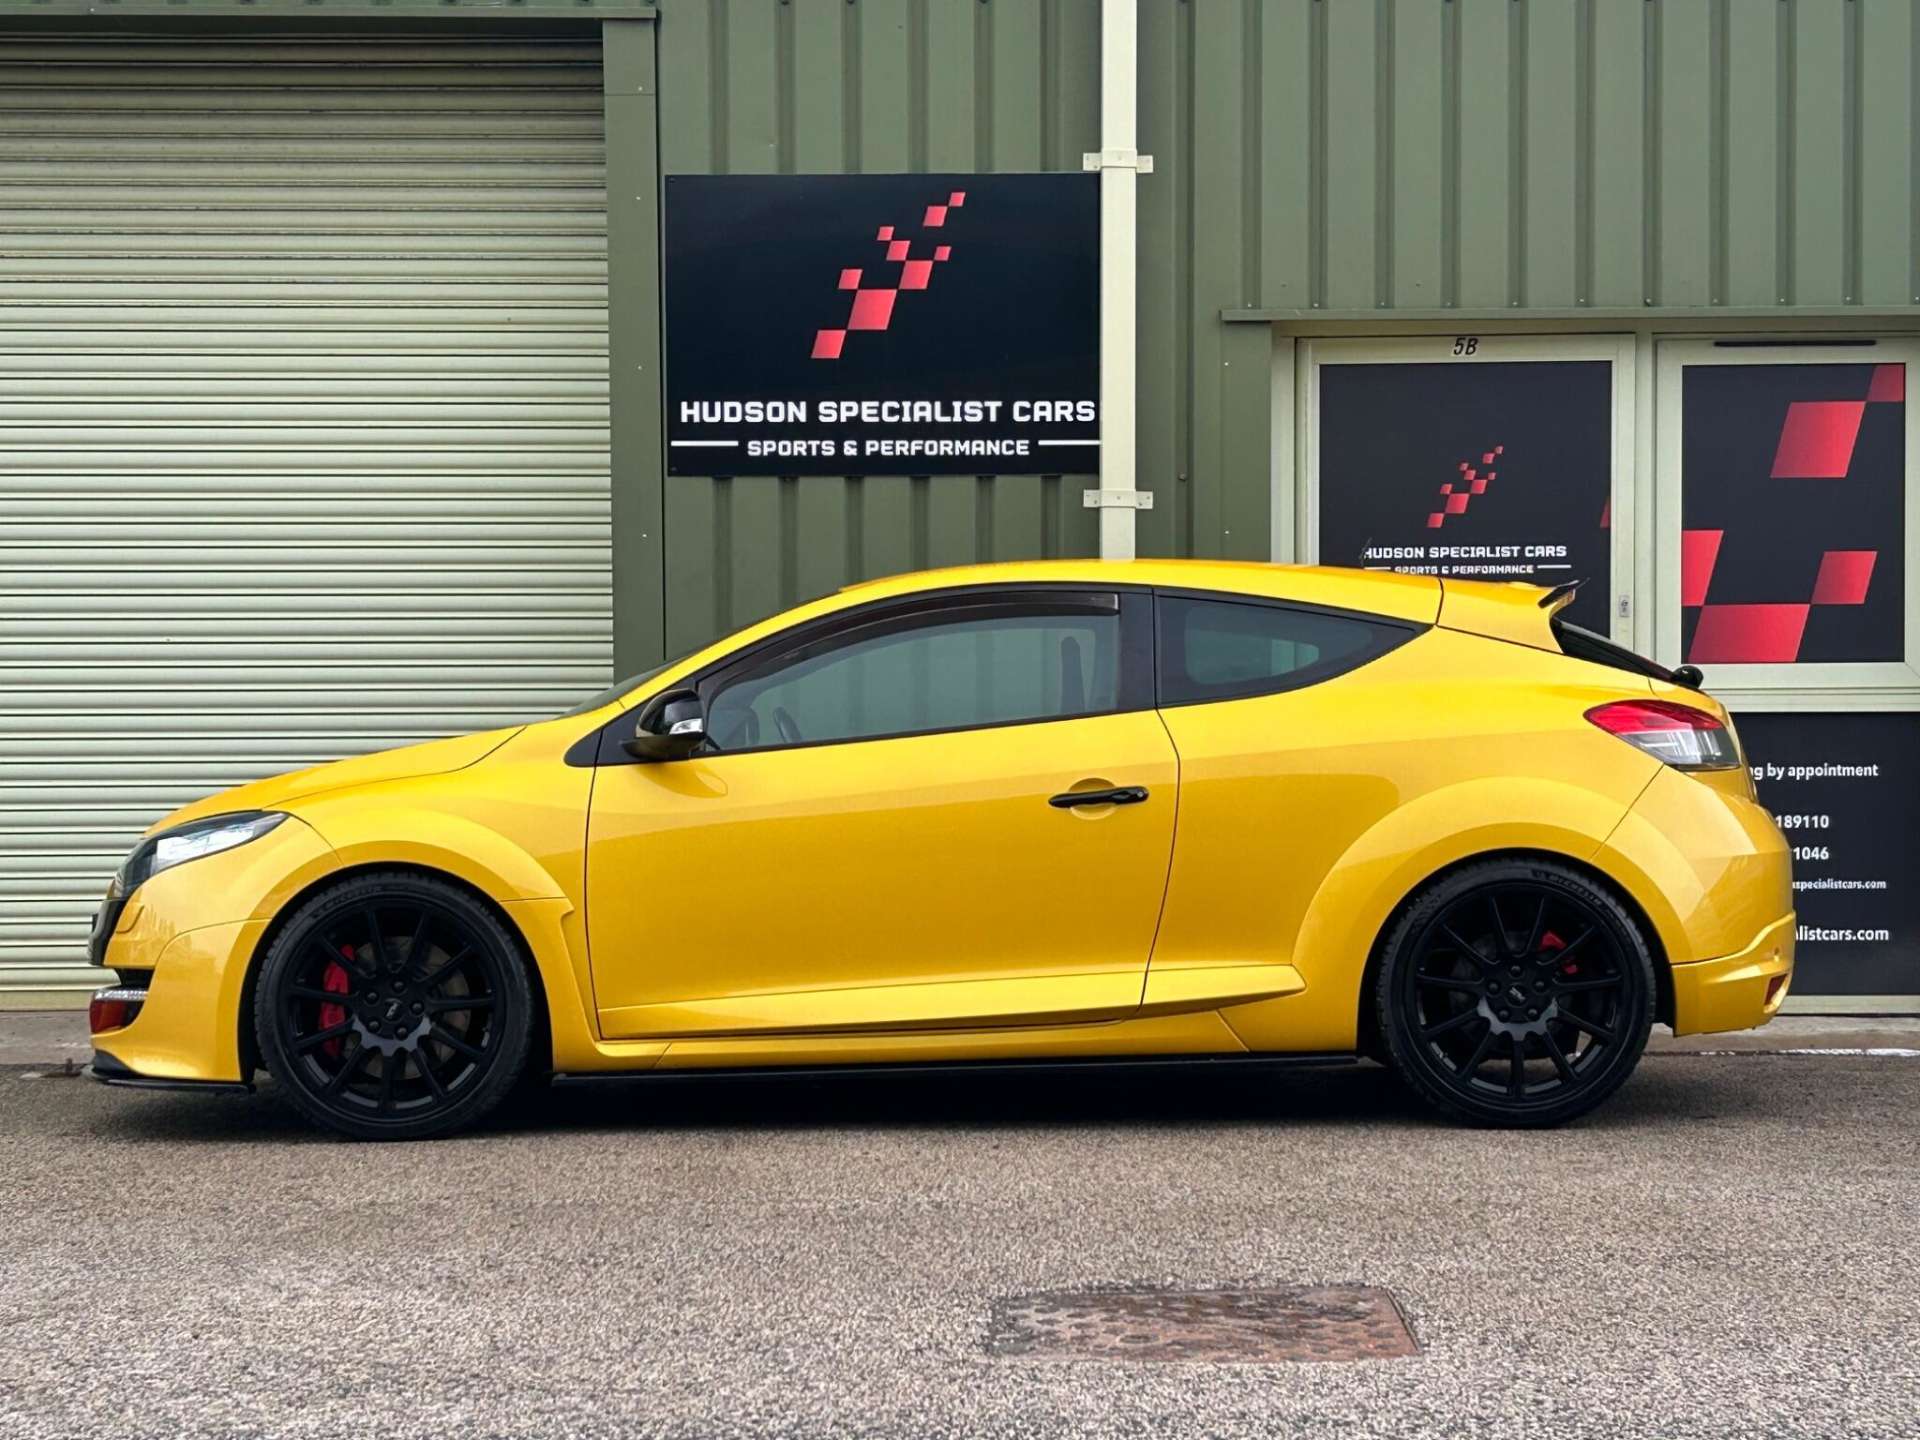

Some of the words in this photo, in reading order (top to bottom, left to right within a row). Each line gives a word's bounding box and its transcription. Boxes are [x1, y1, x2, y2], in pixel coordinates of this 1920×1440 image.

[1454, 337, 1479, 355] 5B
[681, 401, 806, 422] HUDSON
[819, 401, 1002, 422] SPECIALIST
[1013, 401, 1095, 422] CARS
[748, 440, 835, 456] SPORTS
[844, 440, 857, 456] &
[866, 440, 1029, 456] PERFORMANCE
[1364, 547, 1424, 559] HUDSON
[1429, 546, 1520, 559] SPECIALIST
[1525, 545, 1566, 558] CARS
[1395, 566, 1438, 575] SPORTS
[1452, 565, 1534, 574] PERFORMANCE
[1767, 763, 1785, 780] by
[1788, 763, 1878, 780] appointment
[1776, 815, 1829, 829] 189110
[1793, 847, 1829, 860] 1046
